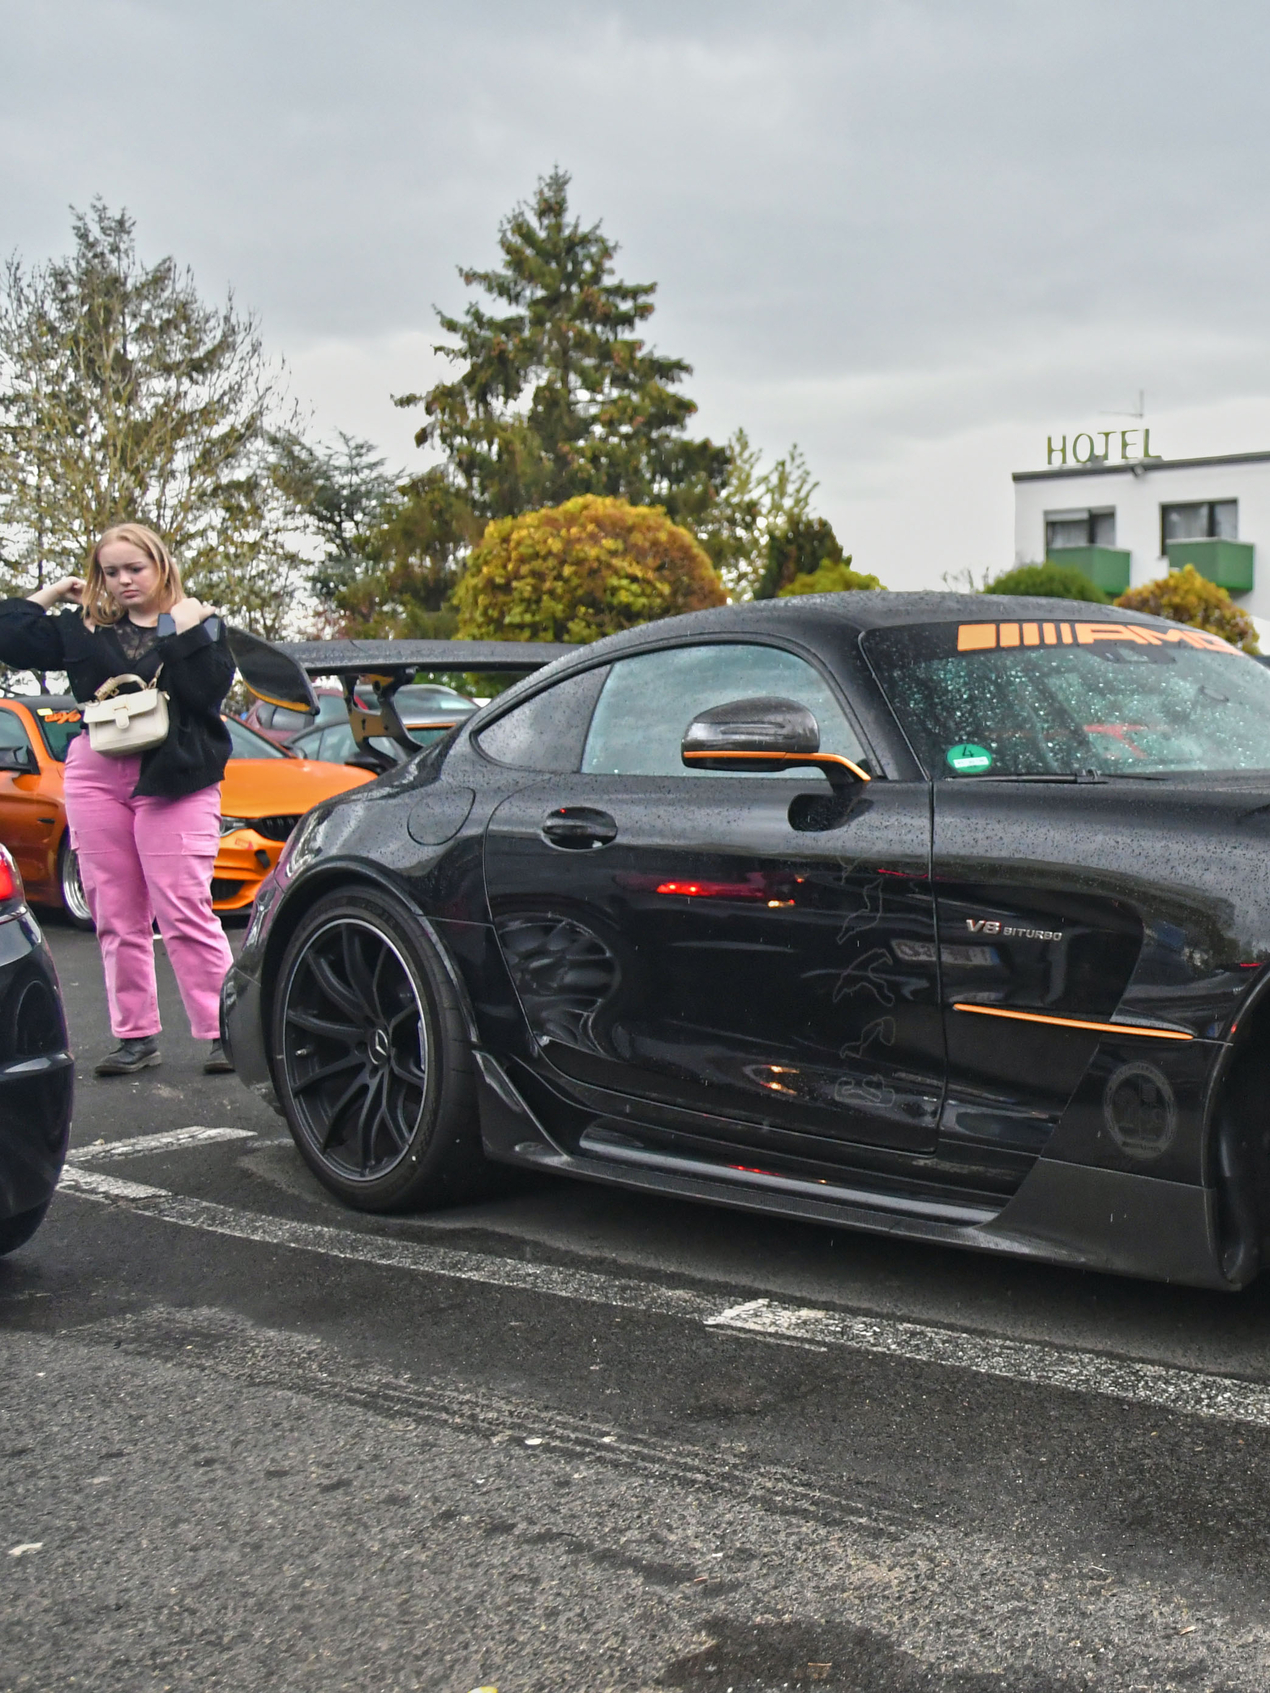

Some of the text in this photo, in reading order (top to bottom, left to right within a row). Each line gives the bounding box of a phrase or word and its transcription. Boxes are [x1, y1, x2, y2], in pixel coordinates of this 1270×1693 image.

[1047, 428, 1162, 466] HOTEL
[1074, 622, 1247, 656] AMG
[962, 745, 974, 758] 4
[966, 918, 1063, 942] V8 BITURBO
